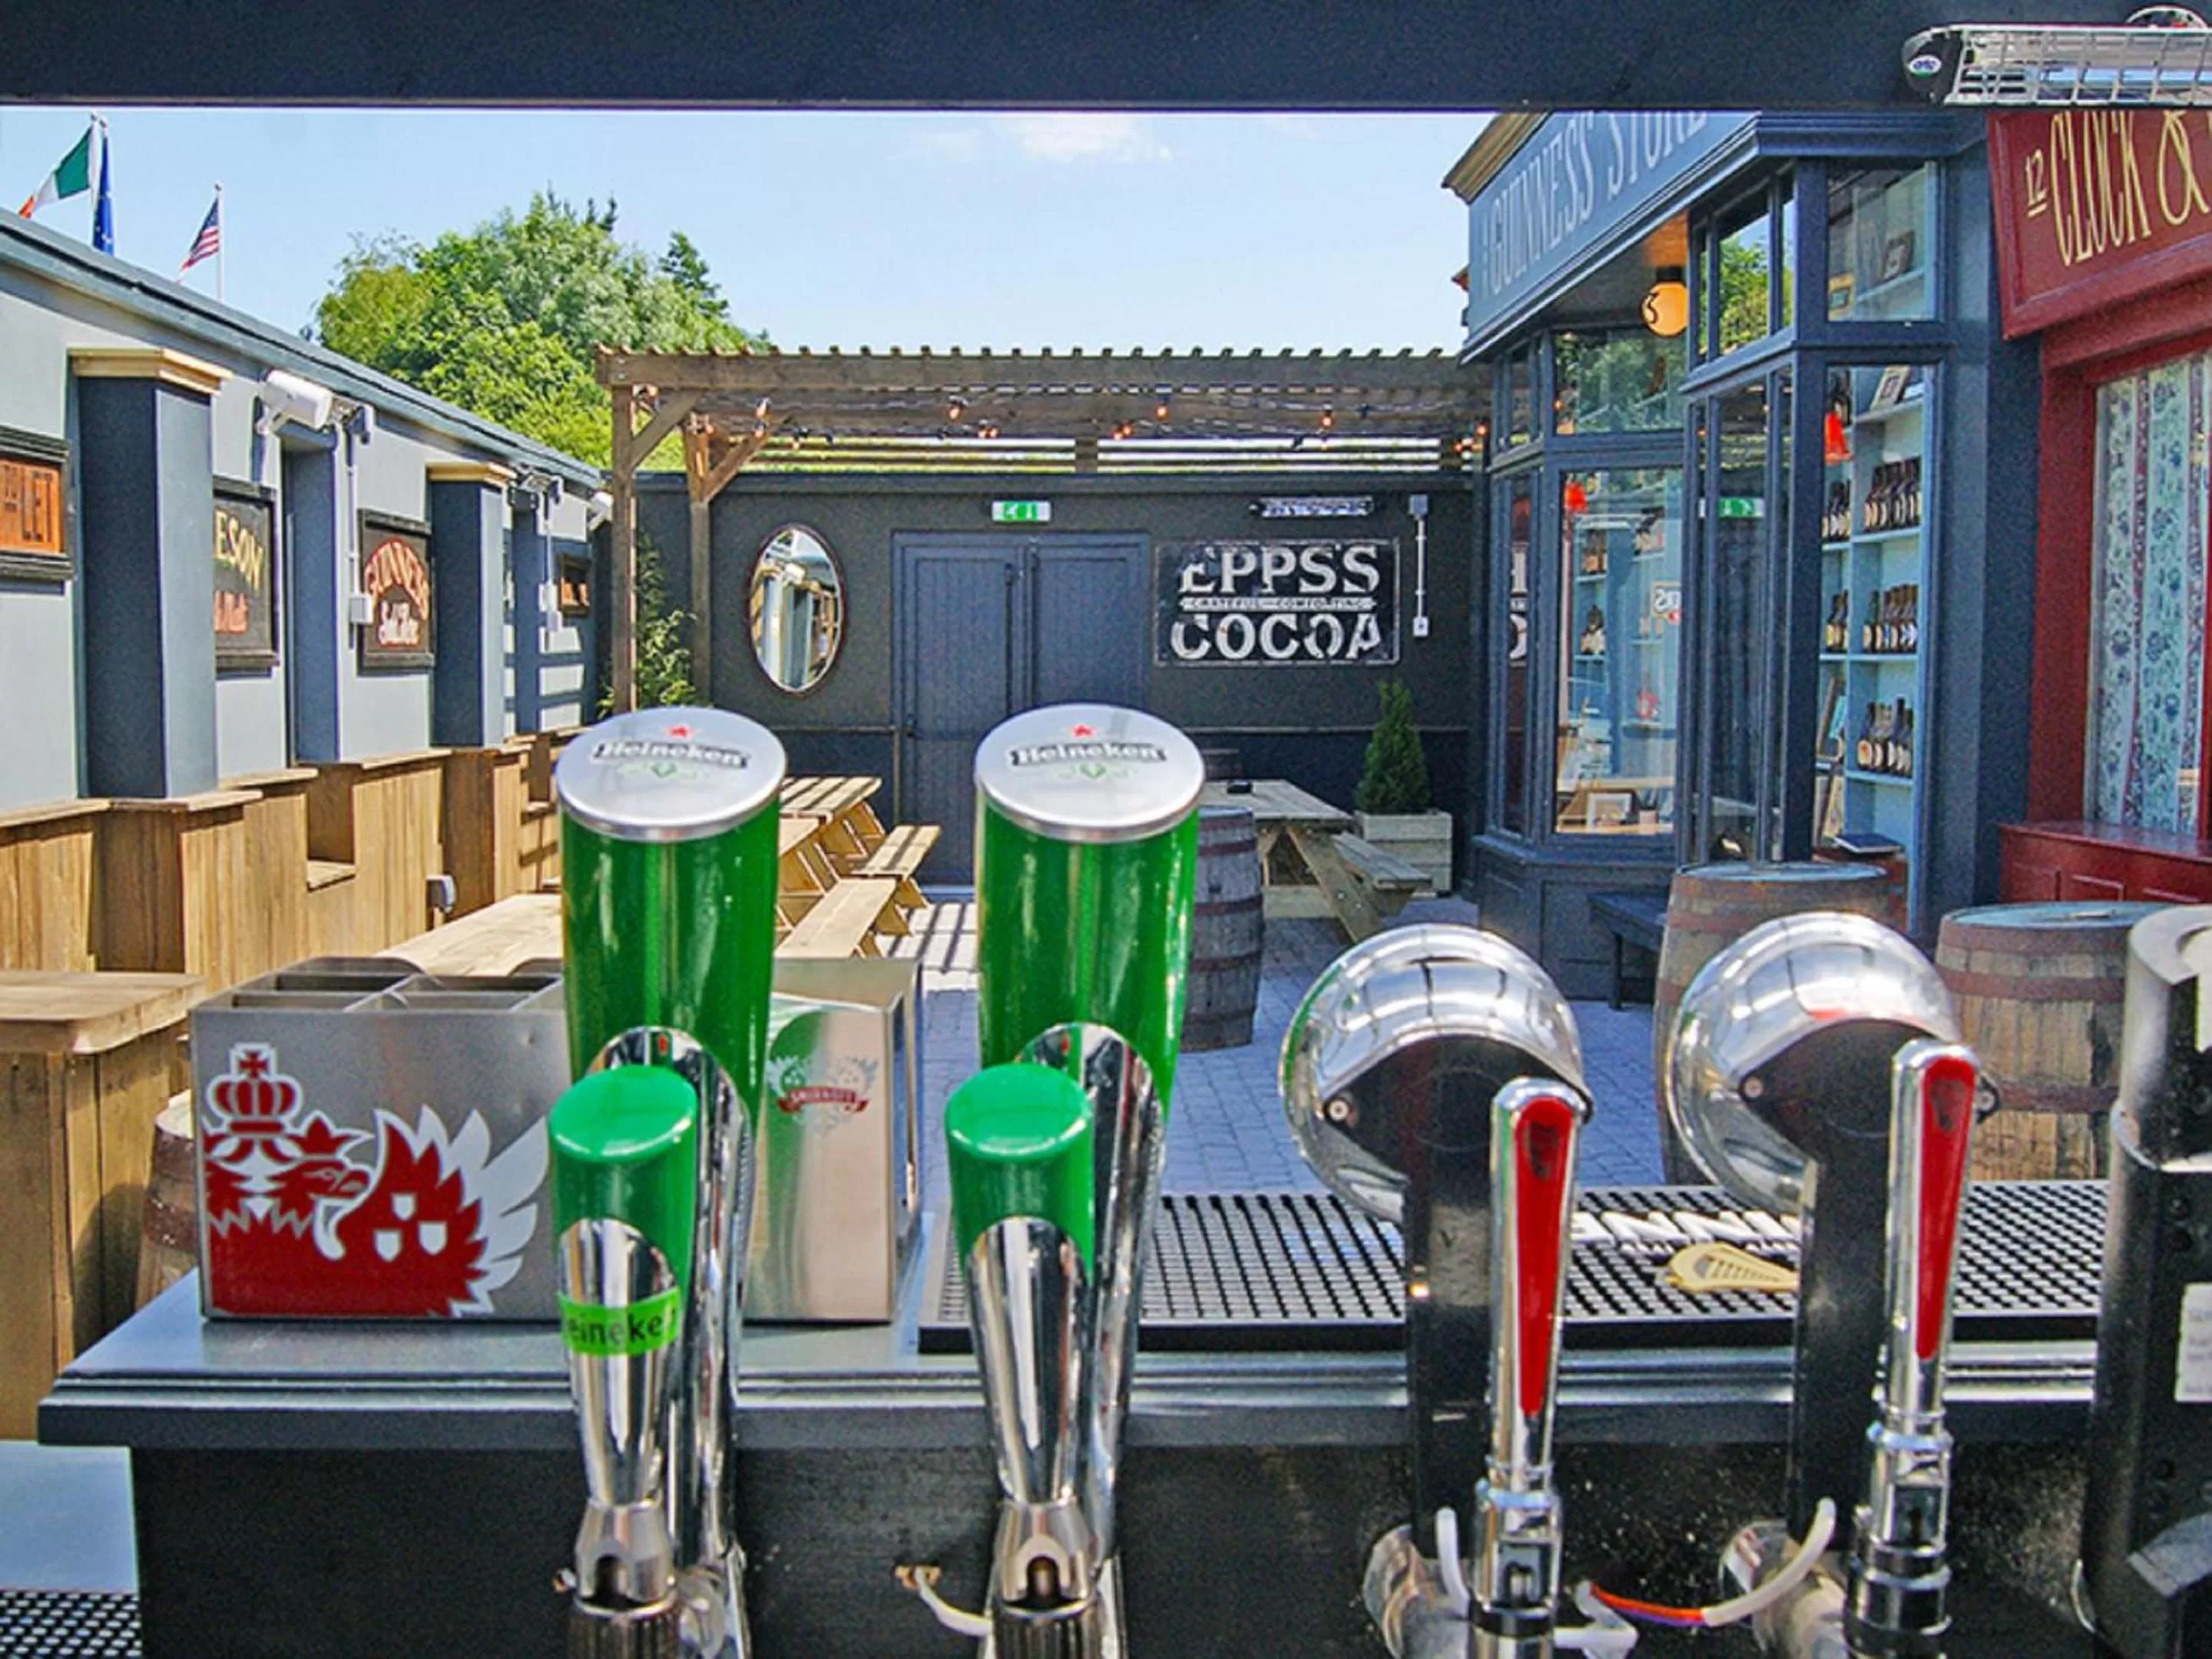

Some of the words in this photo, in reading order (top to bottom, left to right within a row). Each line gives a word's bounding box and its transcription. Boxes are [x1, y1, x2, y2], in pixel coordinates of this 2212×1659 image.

[1488, 112, 1595, 295] GUINNESS
[2025, 149, 2048, 217] 12
[2051, 112, 2152, 267] CLOCK
[214, 510, 263, 592] ESON
[1170, 613, 1381, 660] COCOA
[596, 740, 743, 767] Heineken
[1018, 742, 1161, 765] Heineken
[569, 1309, 677, 1345] eineke
